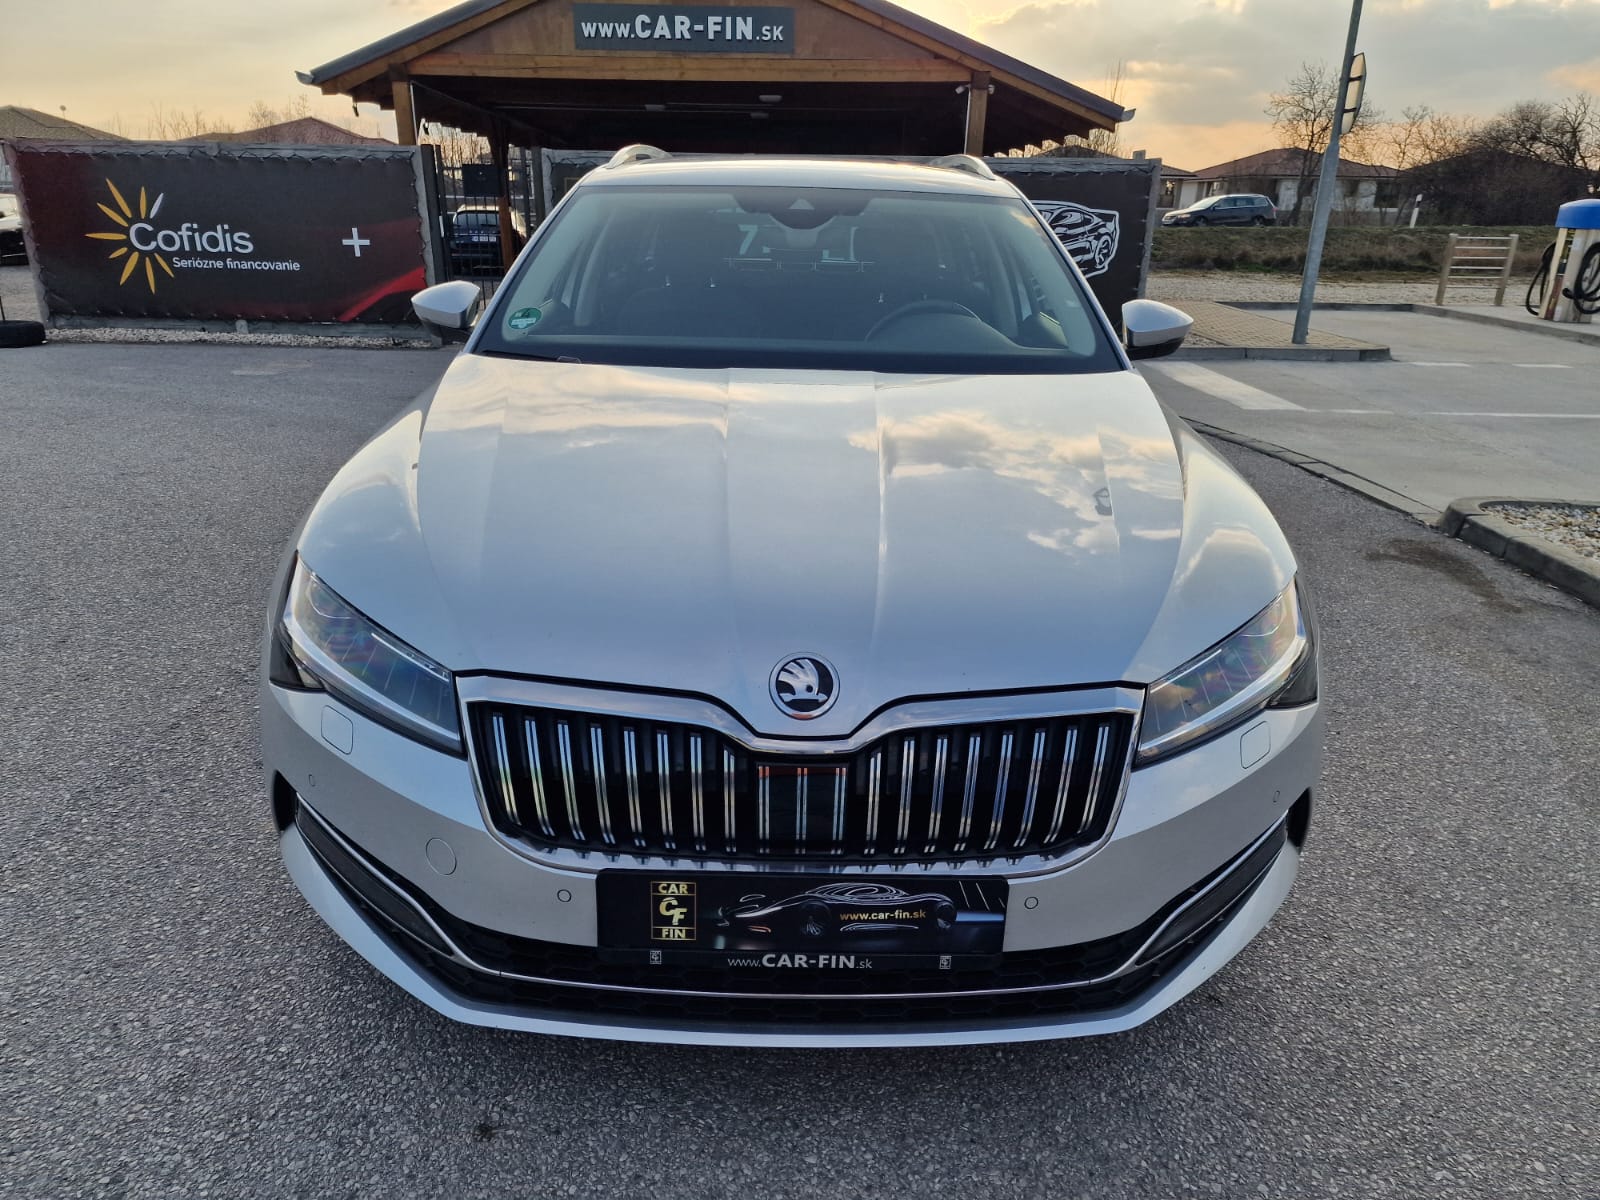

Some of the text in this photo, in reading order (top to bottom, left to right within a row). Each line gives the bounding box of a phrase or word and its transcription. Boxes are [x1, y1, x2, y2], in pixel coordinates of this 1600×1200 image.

[129, 222, 254, 253] Cofidis
[172, 256, 301, 272] Seriózne financovanie
[658, 883, 688, 894] CAR
[839, 909, 926, 921] www.car-fin.sk
[662, 928, 686, 939] FIN
[727, 953, 873, 969] www.CAR-FIN.sk
